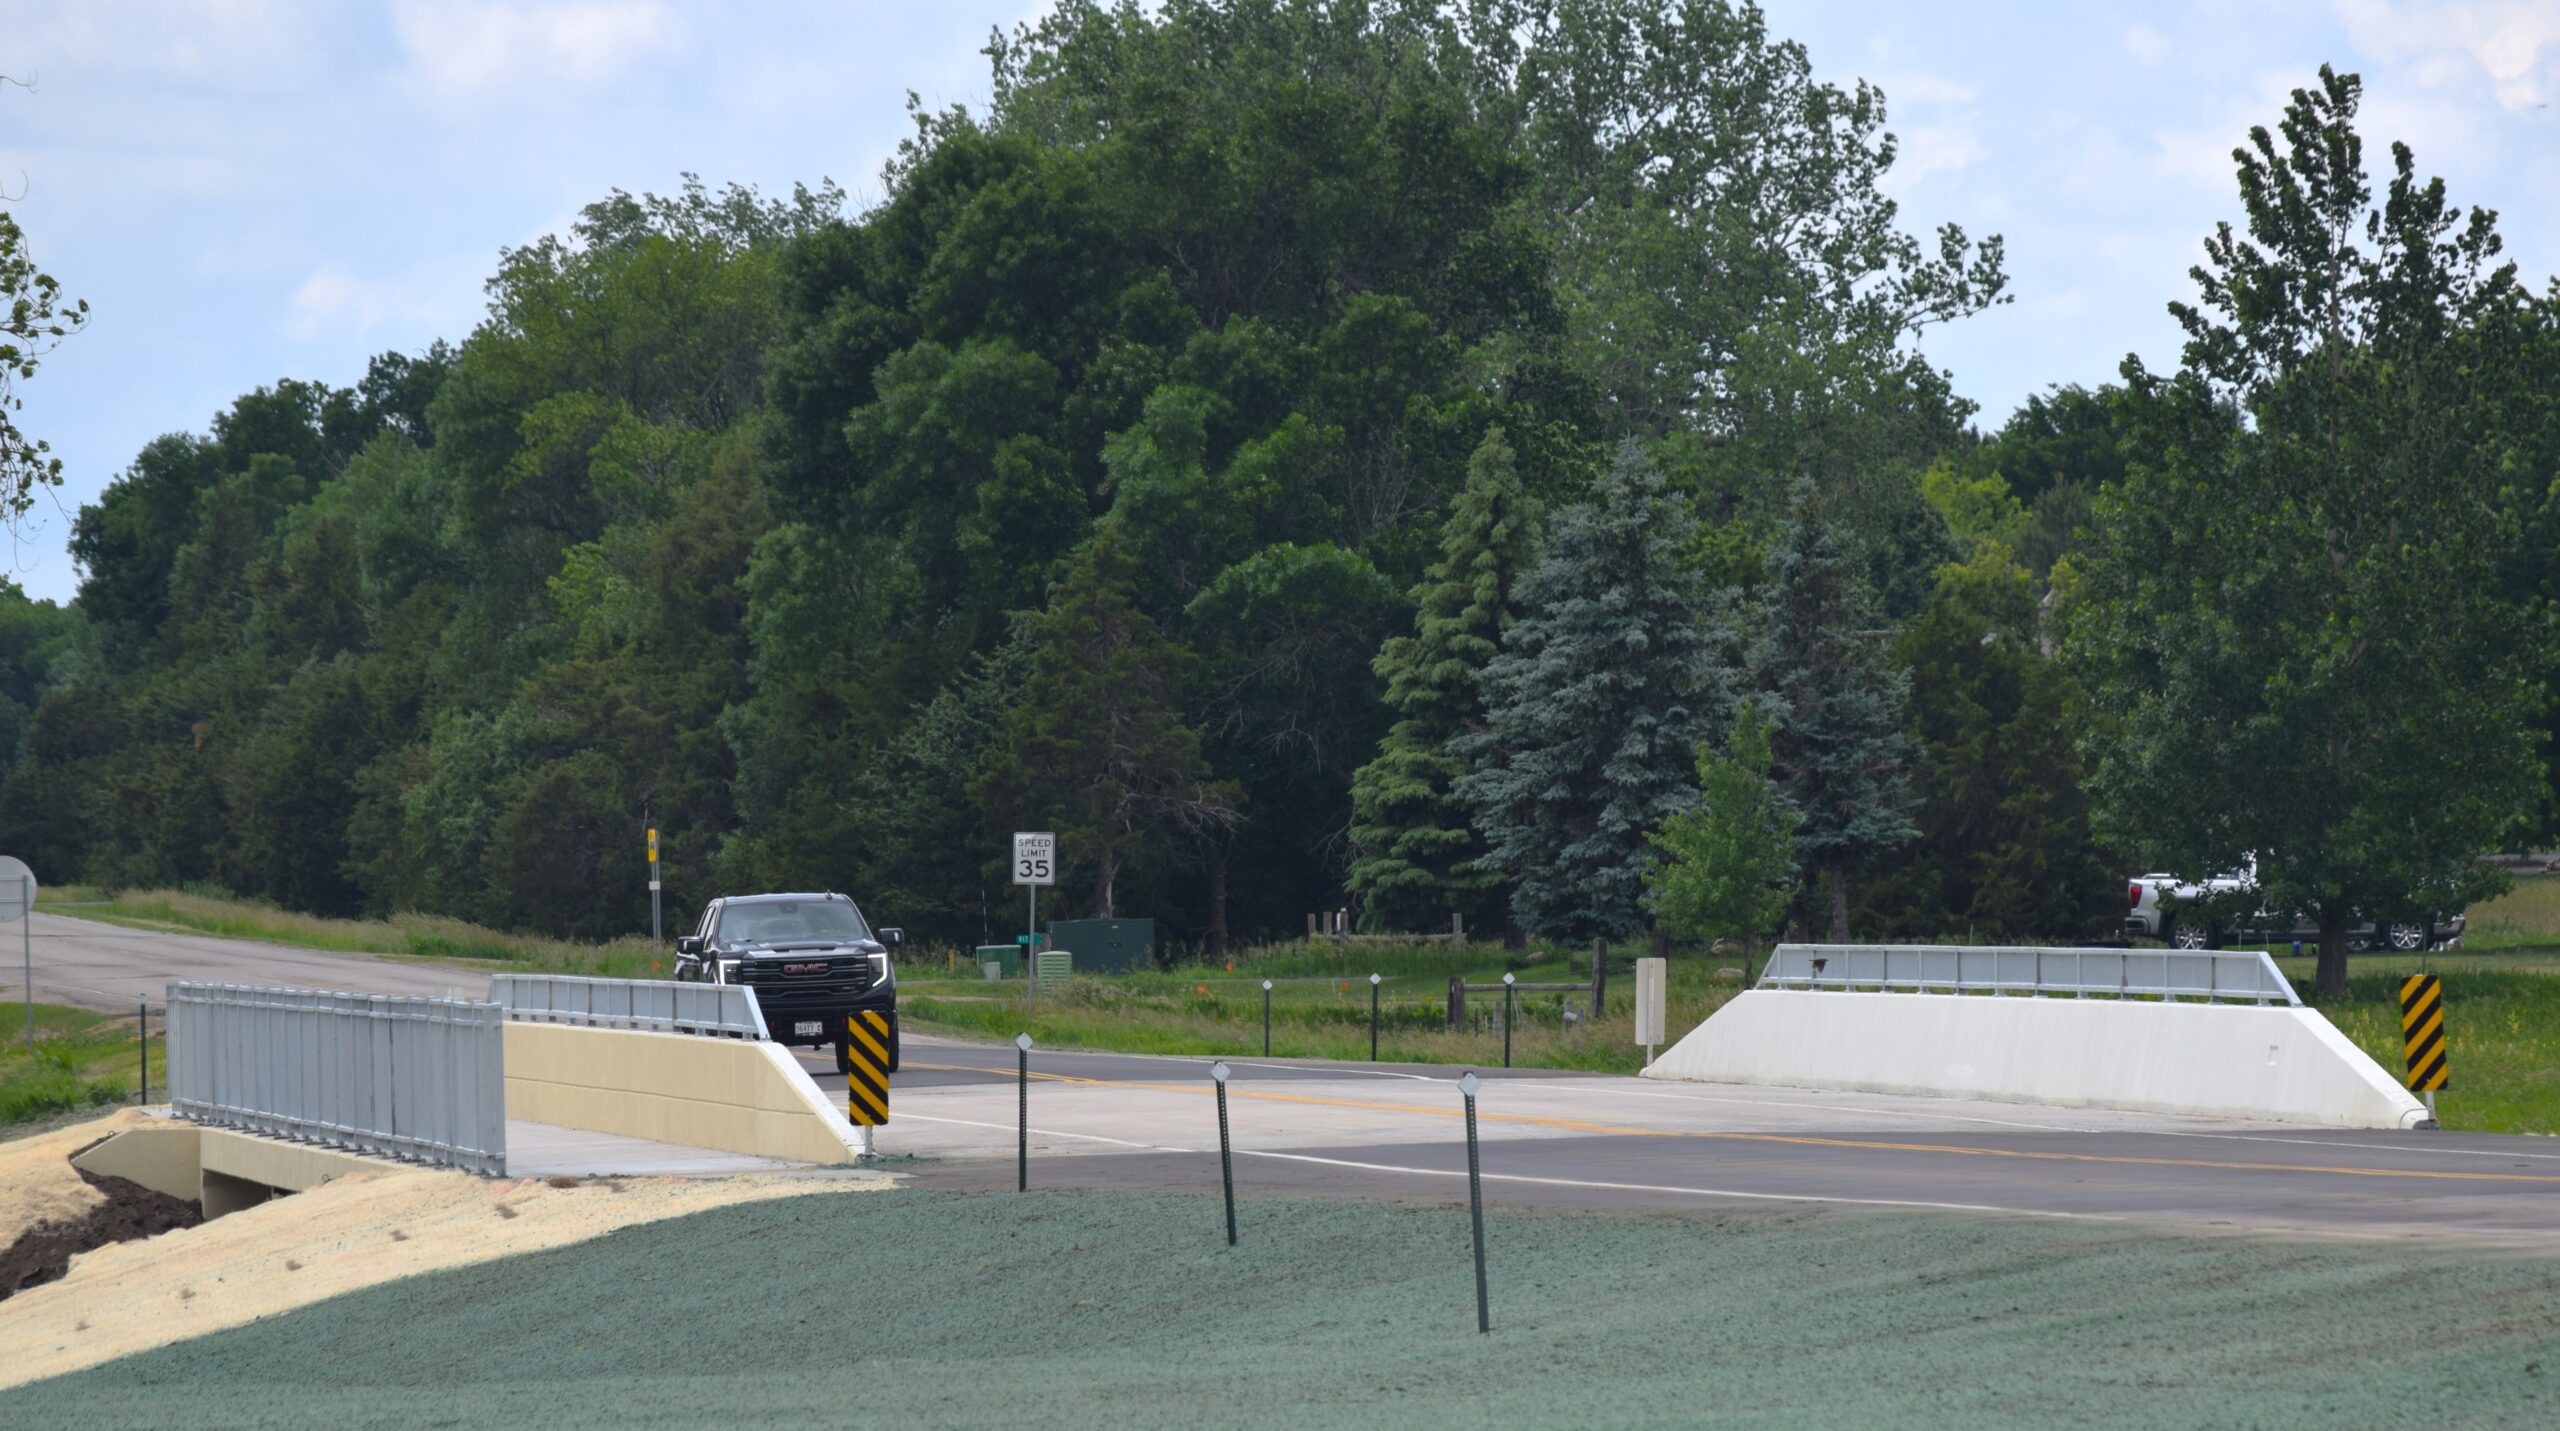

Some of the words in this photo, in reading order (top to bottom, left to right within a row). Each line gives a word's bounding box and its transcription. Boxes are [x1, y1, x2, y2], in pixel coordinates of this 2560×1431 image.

[1018, 839, 1051, 847] SPEED
[1019, 859, 1049, 878] 35
[784, 963, 828, 973] GMC
